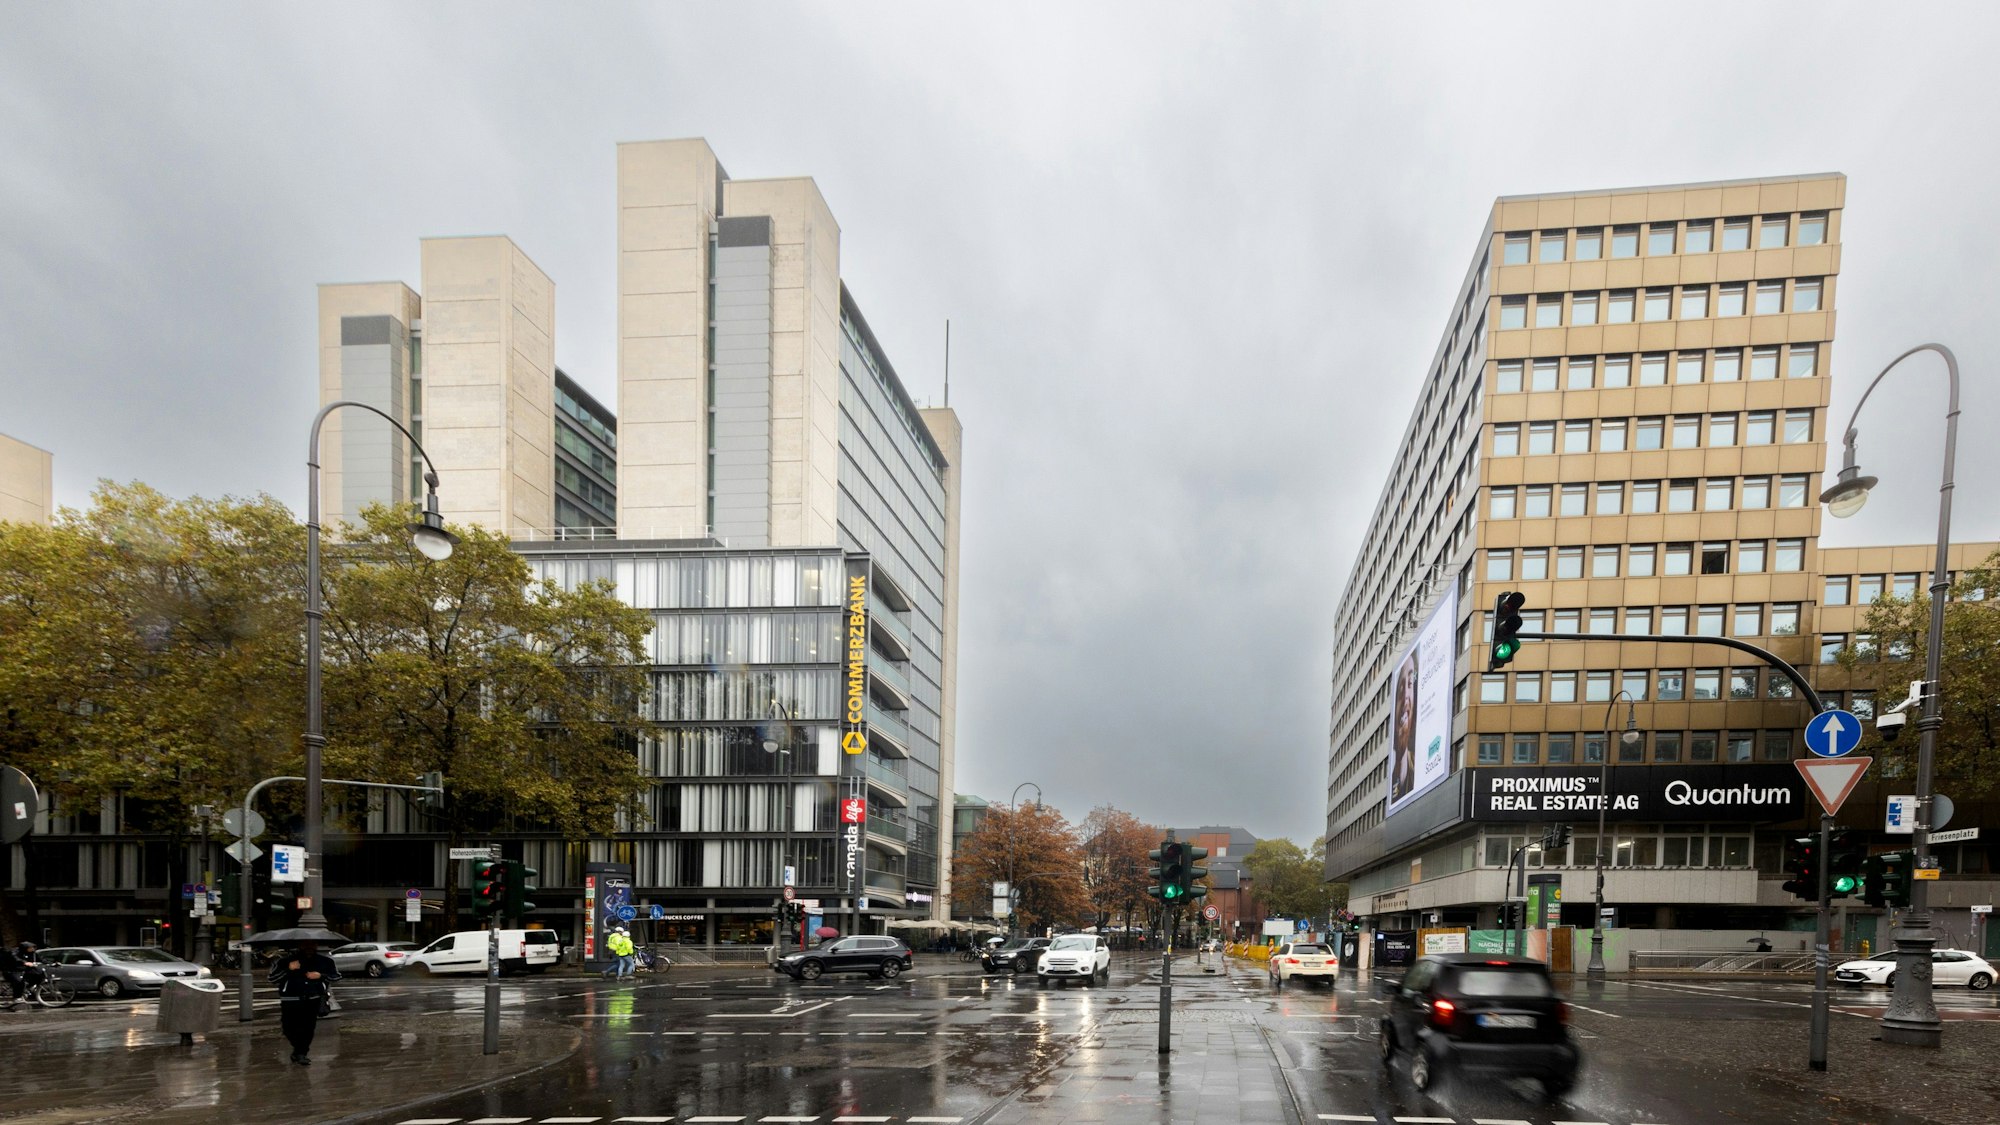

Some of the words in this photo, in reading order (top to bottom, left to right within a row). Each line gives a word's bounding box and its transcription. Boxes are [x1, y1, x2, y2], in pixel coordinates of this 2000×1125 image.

[848, 575, 866, 724] COMMERZBANK
[1491, 795, 1537, 810] REAL
[1542, 795, 1608, 810] ESTATE
[1613, 795, 1639, 810] AG
[1665, 780, 1791, 805] Quantum
[846, 799, 863, 823] life
[1931, 830, 1974, 841] Friesenplatz
[451, 849, 491, 858] Hohenzollernring
[844, 825, 858, 878] canada
